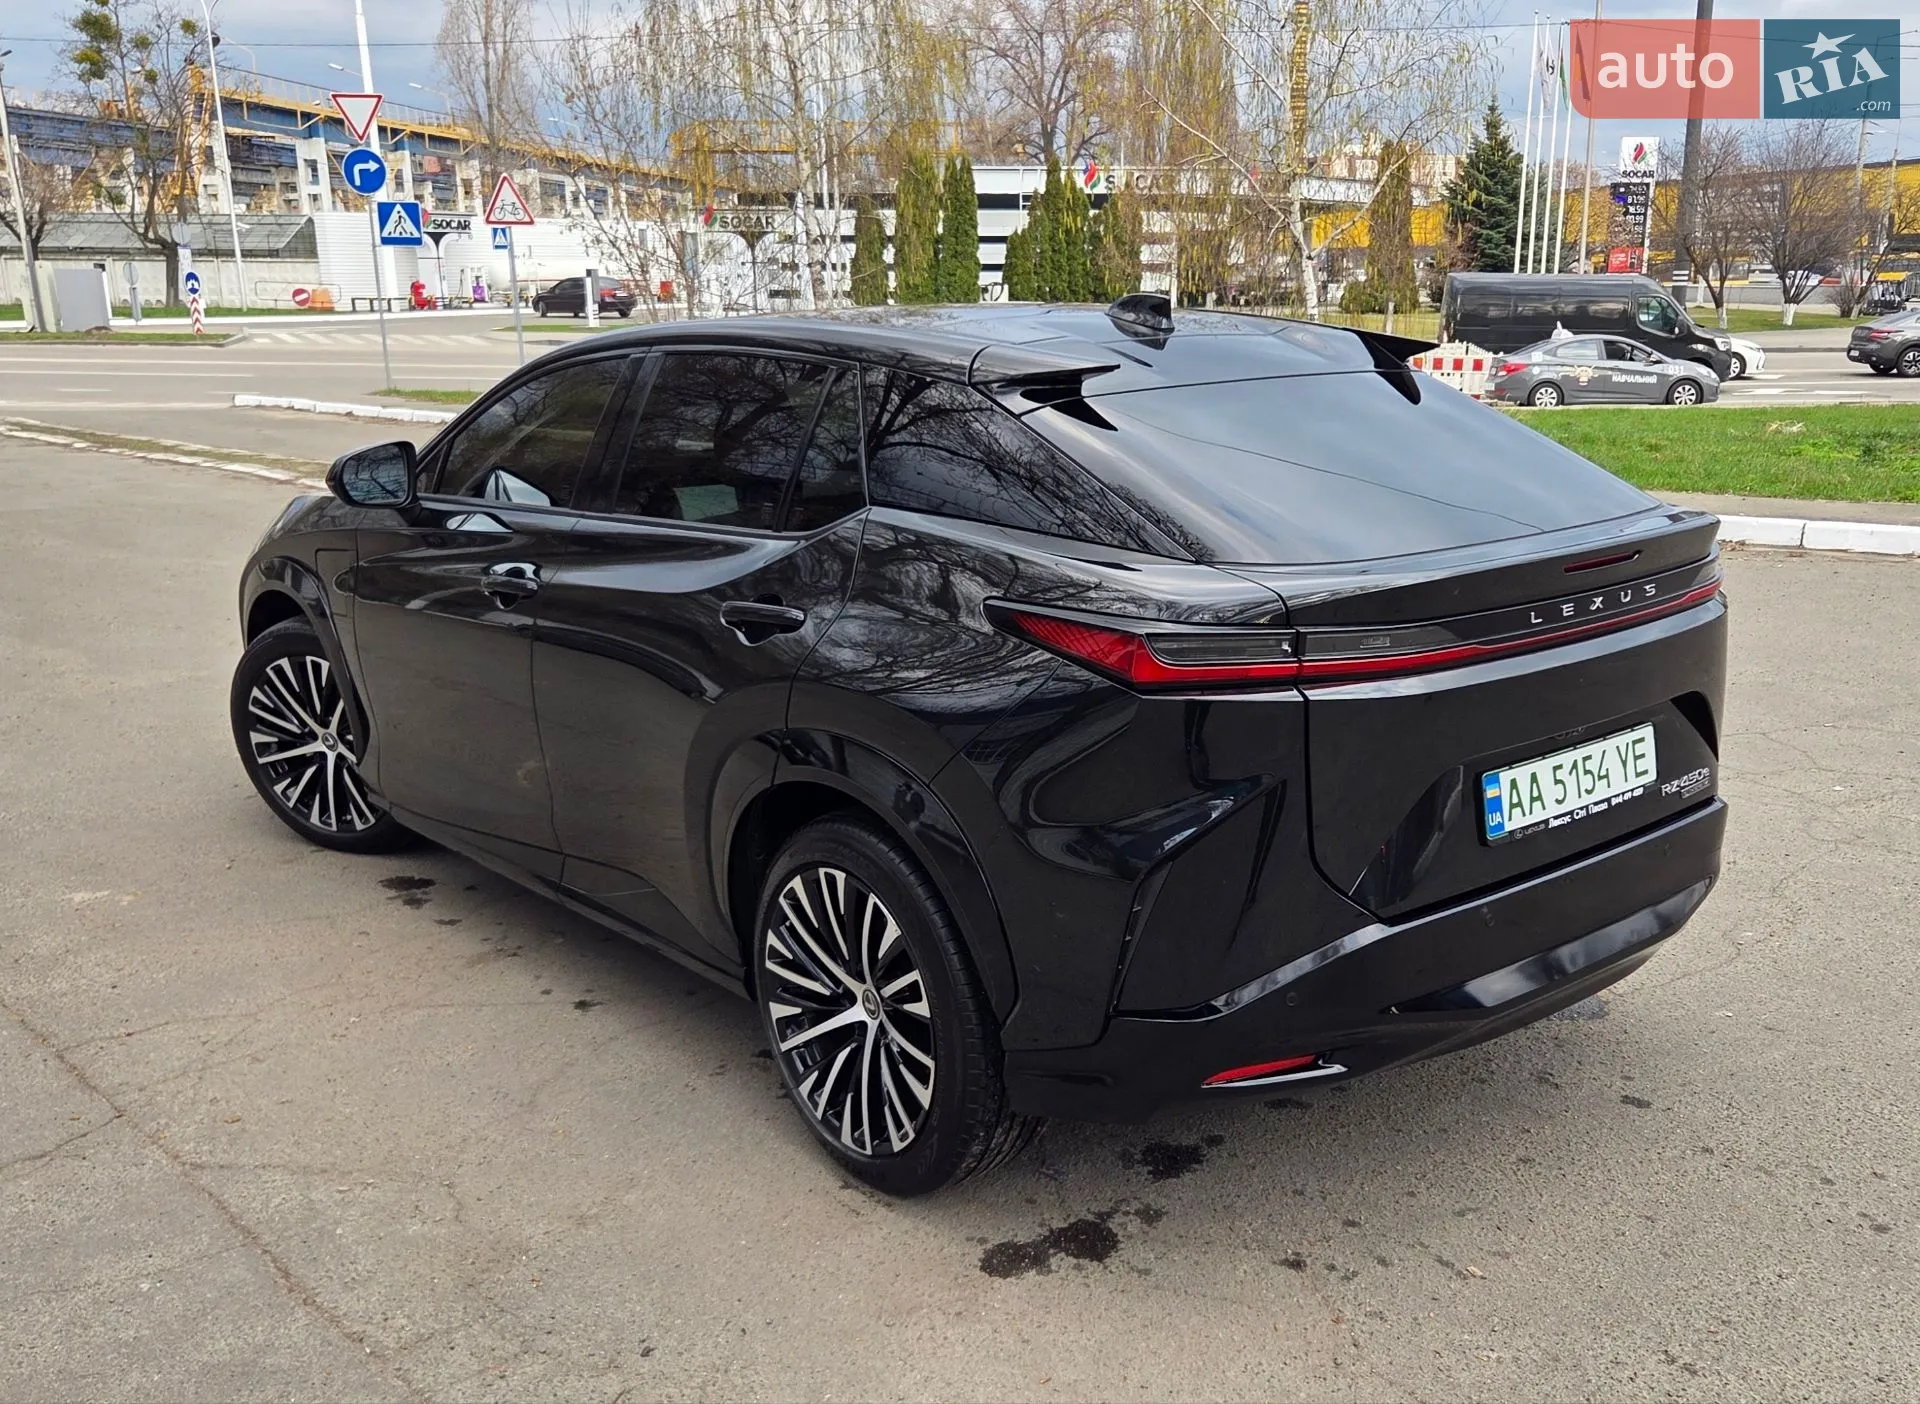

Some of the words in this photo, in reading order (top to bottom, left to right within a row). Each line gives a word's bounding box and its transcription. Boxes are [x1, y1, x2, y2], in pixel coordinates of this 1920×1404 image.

[1622, 170, 1655, 179] SOCAR
[431, 219, 471, 231] SOCAR
[718, 215, 776, 230] SOCAR
[1530, 583, 1656, 624] LEXUS
[1508, 771, 1546, 822] AA
[1552, 749, 1611, 806] 5154
[1616, 737, 1649, 783] YE
[1489, 811, 1503, 827] UA
